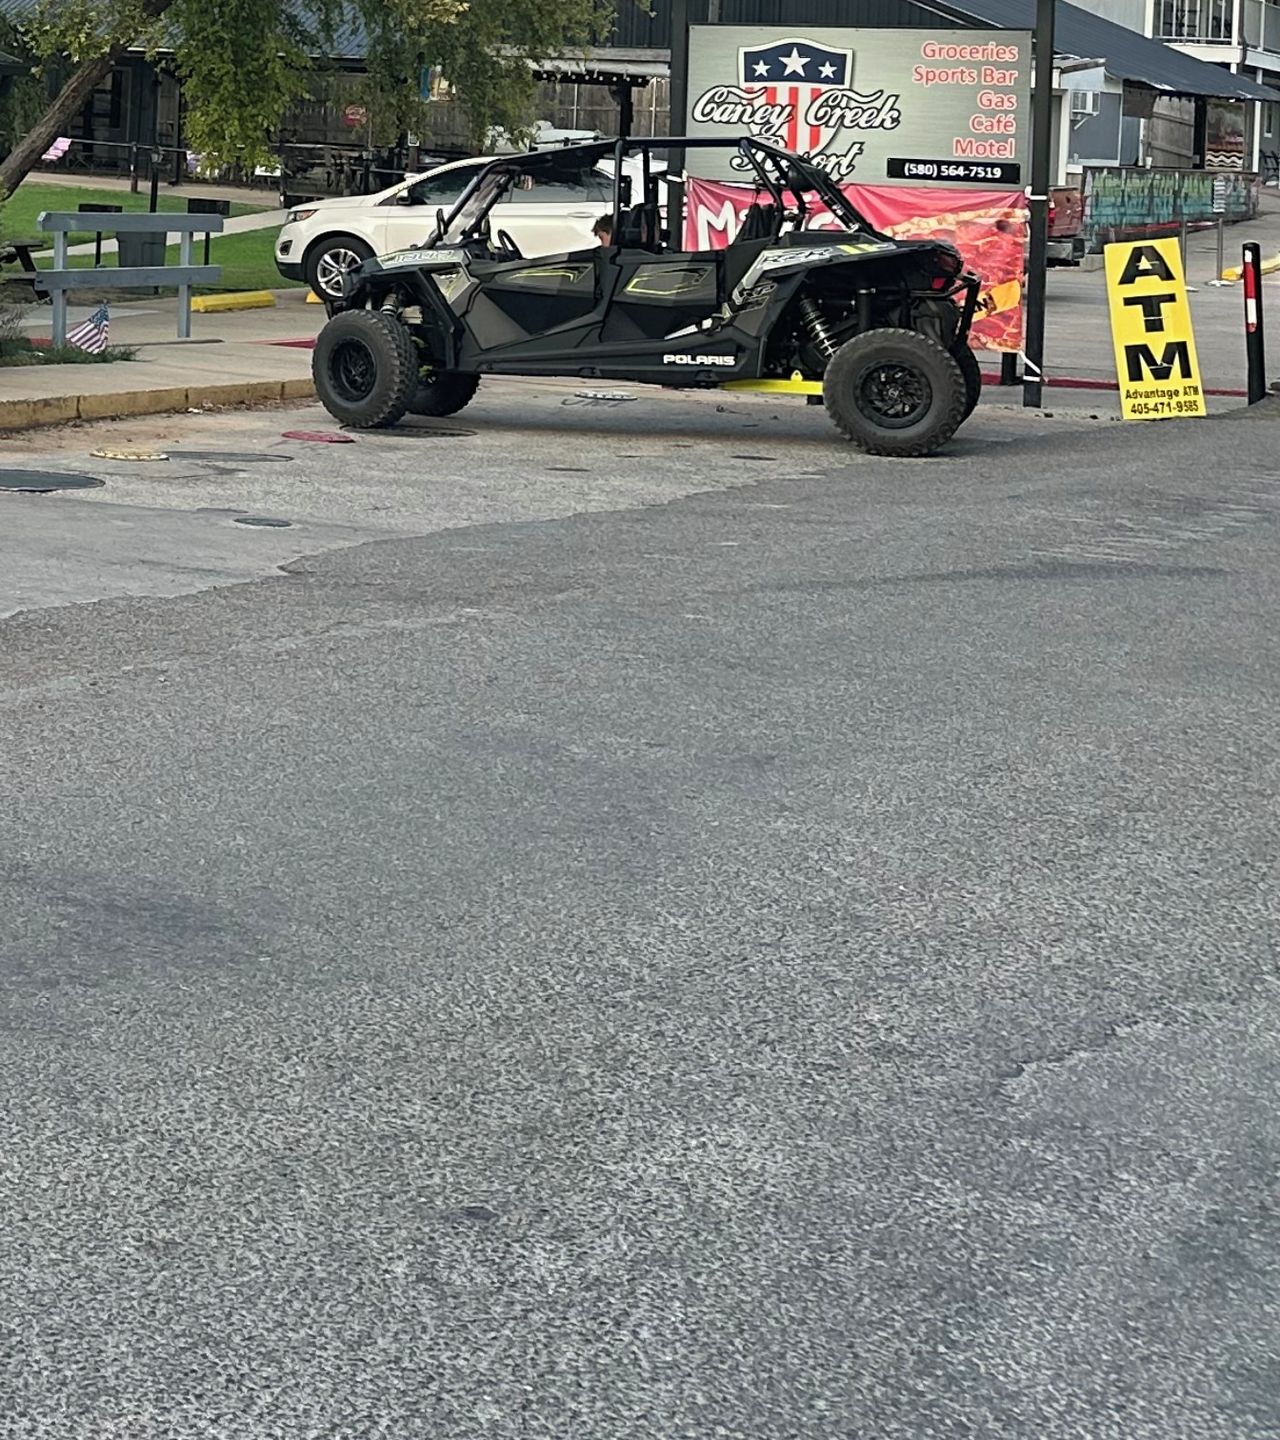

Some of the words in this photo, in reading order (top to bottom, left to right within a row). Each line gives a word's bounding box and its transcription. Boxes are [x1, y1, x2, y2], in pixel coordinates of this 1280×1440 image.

[921, 40, 1019, 61] Groceries
[912, 64, 977, 88] Sports
[981, 66, 1018, 86] Bar
[977, 89, 1017, 109] Gas
[692, 85, 795, 136] Caney
[804, 87, 901, 130] Creek
[969, 113, 1016, 134] Café
[952, 137, 1016, 158] Motel
[904, 162, 938, 178] (580)
[940, 164, 1002, 179] 564-7519
[1118, 245, 1193, 382] ATM
[663, 354, 736, 366] POLARIS
[1125, 386, 1180, 400] Advantage
[1183, 385, 1199, 397] ATM
